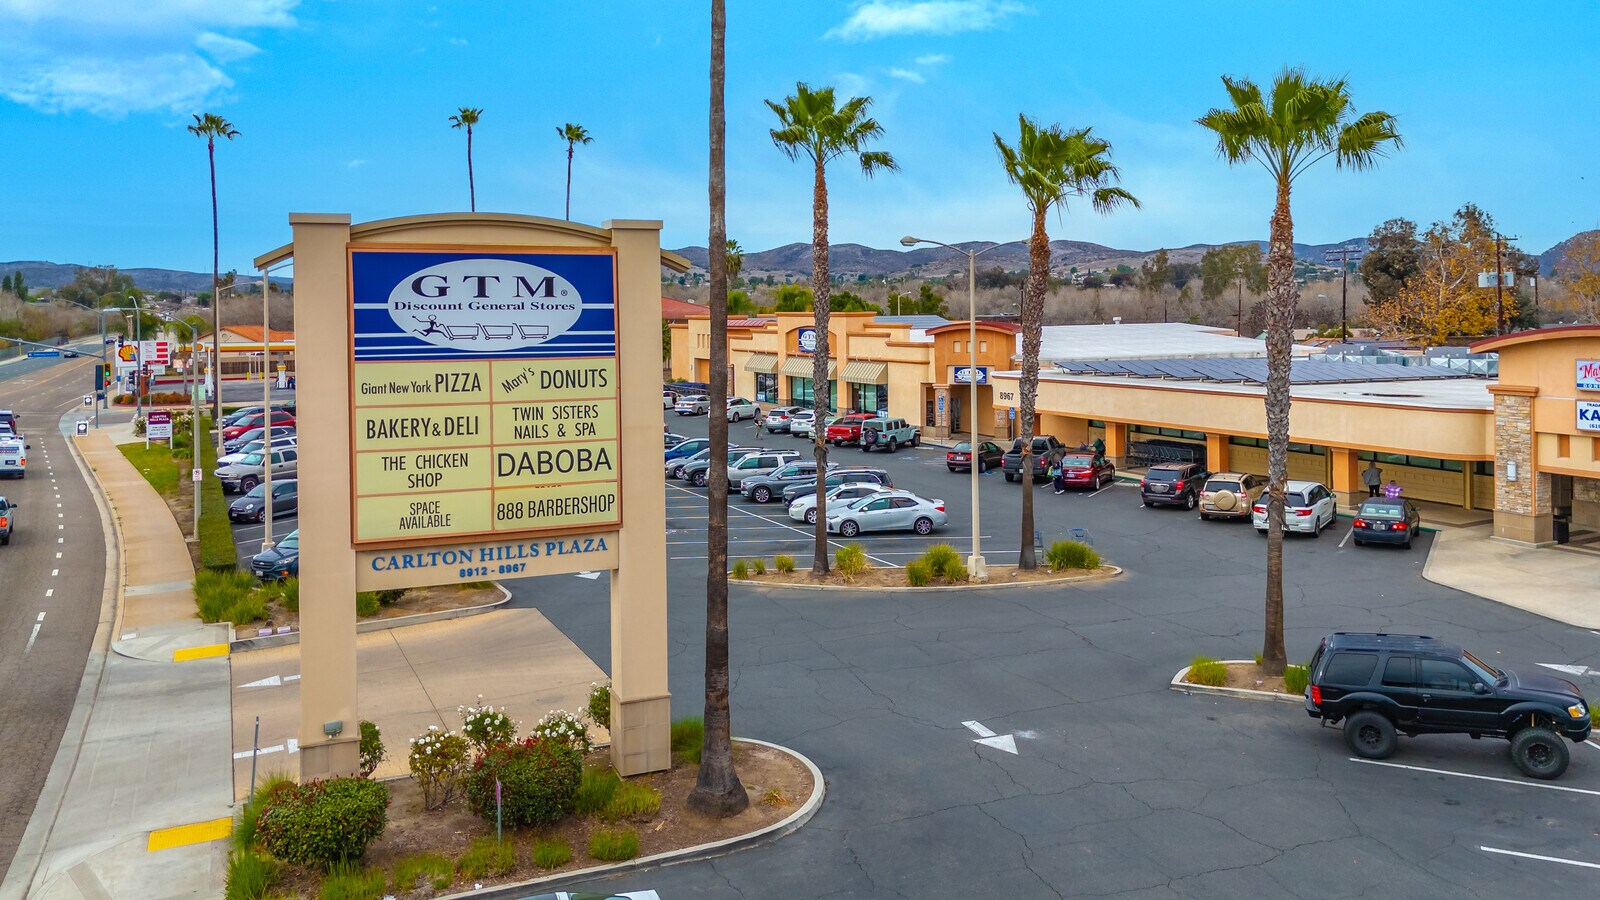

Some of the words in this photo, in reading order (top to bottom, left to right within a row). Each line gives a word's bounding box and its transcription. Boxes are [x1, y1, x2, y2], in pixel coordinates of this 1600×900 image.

[411, 275, 557, 298] GTM
[394, 302, 463, 310] Discount
[468, 302, 524, 310] General
[530, 302, 575, 310] Stores
[1579, 363, 1600, 380] Ma
[362, 383, 387, 394] Giant
[389, 382, 409, 393] New
[411, 380, 431, 393] York
[435, 373, 481, 392] PIZZA
[502, 368, 534, 393] Mary's
[541, 369, 607, 389] DONUTS
[1000, 392, 1014, 400] 8967
[512, 407, 543, 421] TWIN
[552, 405, 598, 419] SISTERS
[367, 418, 431, 439] BAKERY
[445, 416, 478, 436] DELI
[515, 424, 548, 439] NAILS
[558, 423, 566, 437] &
[575, 422, 596, 436] SPA
[382, 456, 406, 471] THE
[416, 453, 468, 469] CHICKEN
[498, 448, 612, 477] DABOBA
[408, 473, 442, 488] SHOP
[410, 501, 440, 515] SPACE
[497, 502, 523, 520] 888
[528, 494, 615, 518] BARBERSHOP
[399, 514, 451, 530] AVAILABLE
[372, 548, 473, 571] CARLTON
[479, 543, 539, 562] HILLS
[546, 538, 608, 557] PLAZA
[459, 566, 487, 577] 8912
[499, 563, 526, 573] 8967
